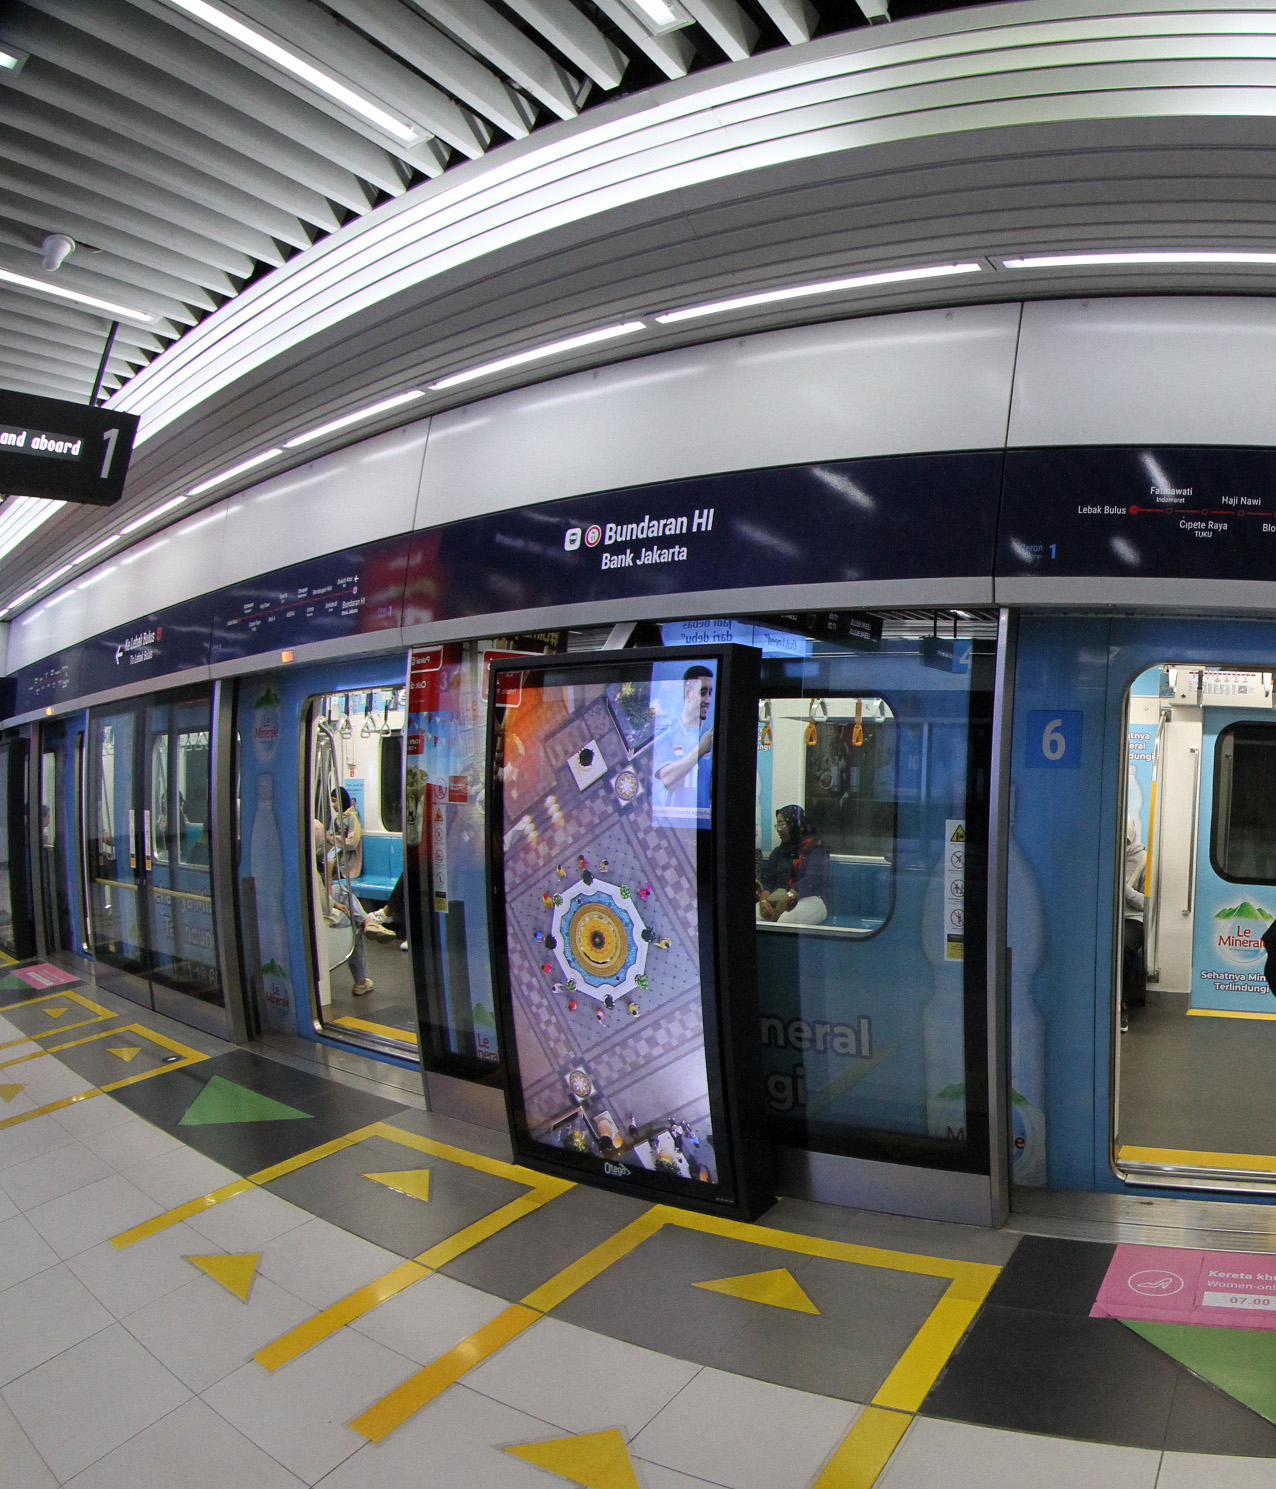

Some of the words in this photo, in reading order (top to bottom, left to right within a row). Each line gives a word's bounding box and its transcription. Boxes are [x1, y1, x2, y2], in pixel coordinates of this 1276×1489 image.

[0, 431, 27, 447] and
[31, 434, 82, 456] aboard
[100, 428, 120, 479] 1
[1222, 496, 1238, 507] Haji
[1240, 497, 1262, 506] Nawi
[1078, 505, 1102, 515] Lebak
[1104, 506, 1127, 515] Bulus
[604, 515, 688, 546] Bundaran
[692, 508, 714, 532] HI
[1179, 519, 1206, 531] Cipete
[1208, 521, 1228, 531] Raya
[601, 549, 633, 570] Bank
[636, 545, 688, 565] Jakarta
[1049, 544, 1057, 559] 1
[1042, 718, 1066, 760] 6
[1128, 732, 1150, 741] tnya
[1129, 742, 1146, 750] eral
[1236, 925, 1252, 938] Le
[1201, 970, 1246, 982] Sehatnya
[1214, 982, 1271, 995] Terlindungi
[477, 1033, 490, 1049] Le
[760, 1016, 871, 1059] neral
[1208, 1270, 1253, 1280] Kereta
[1229, 1296, 1270, 1306] 07.00
